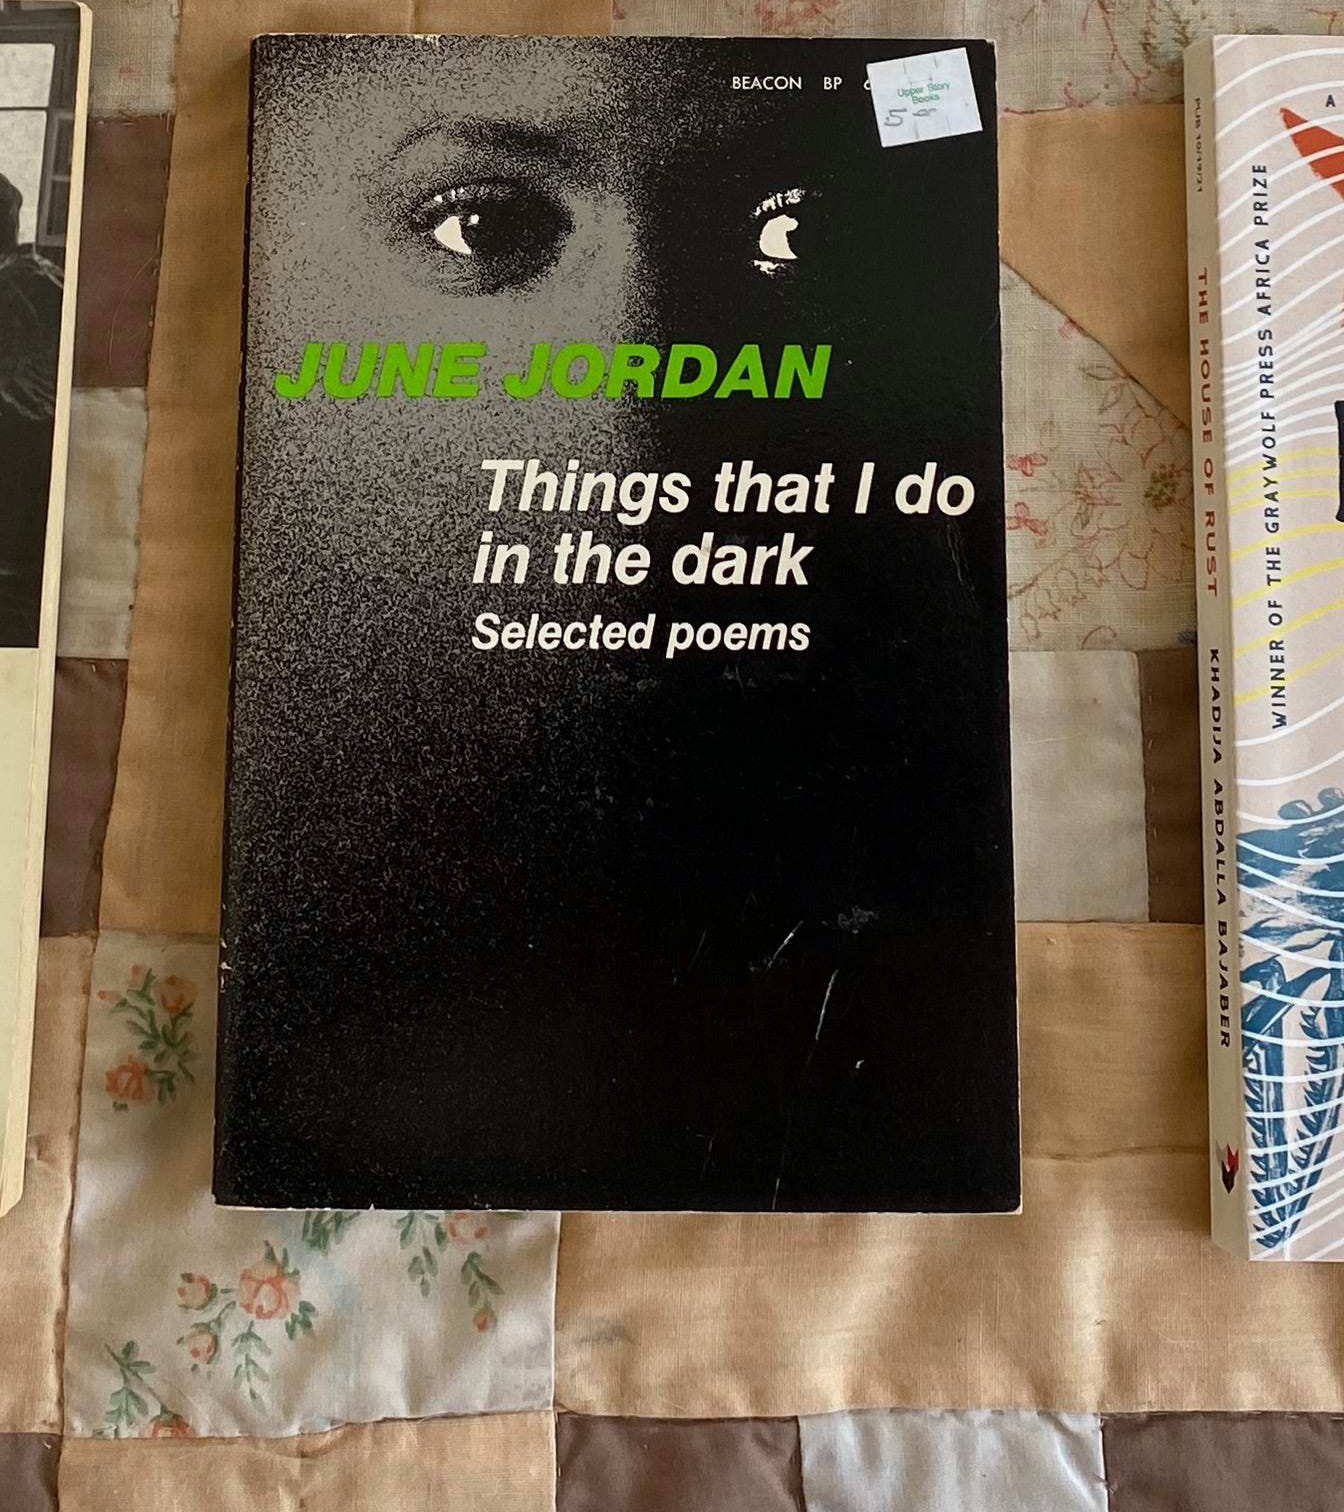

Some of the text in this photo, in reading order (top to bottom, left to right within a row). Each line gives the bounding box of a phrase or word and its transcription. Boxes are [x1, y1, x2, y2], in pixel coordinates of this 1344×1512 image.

[732, 76, 843, 90] BEACON BP
[1325, 94, 1336, 108] A
[274, 342, 832, 400] JUNE JORDAN
[1252, 164, 1288, 730] WINNER OF THE GRAYWOLF PRESS AFRICA PRIZE
[479, 459, 976, 526] Things that I do
[472, 530, 814, 587] in the dark
[471, 614, 811, 660] Selected poems
[1197, 267, 1231, 1049] THE HOUSE OF RUST KHADIJA ABDALLA BAJABER
